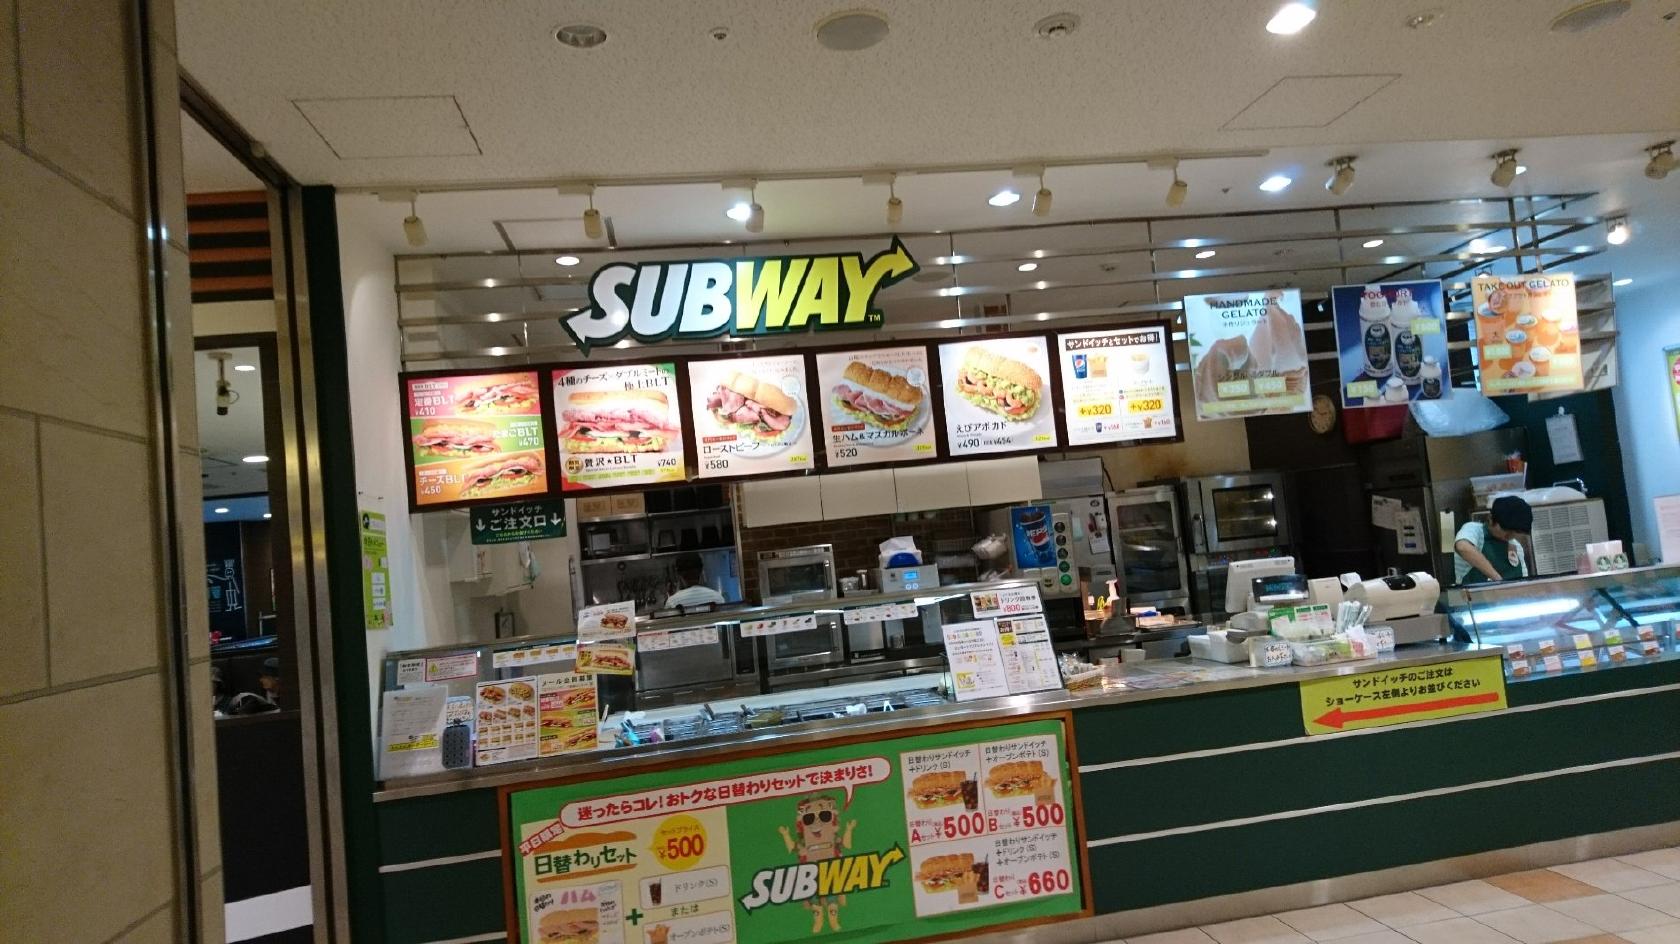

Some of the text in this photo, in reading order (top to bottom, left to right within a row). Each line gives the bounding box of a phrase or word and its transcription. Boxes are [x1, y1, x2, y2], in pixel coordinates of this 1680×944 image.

[1506, 280, 1526, 290] OUT
[1528, 278, 1570, 289] GELATO
[566, 240, 916, 348] SUBWAY
[1210, 297, 1278, 309] HANDMADE
[1221, 308, 1268, 319] GELATO
[956, 421, 1008, 434] えびアボカド
[703, 441, 760, 454] ローストビーフ
[957, 438, 980, 449] ¥490
[835, 447, 858, 459] ¥520
[657, 458, 678, 467] ¥740
[705, 459, 729, 469] ¥580
[491, 505, 543, 517] サンドイッチ
[490, 514, 546, 531] ご注文口
[1351, 667, 1453, 690] サンドイッチのご注文は
[1324, 678, 1481, 708] ショーケース左側よりお並びください
[988, 818, 998, 832] B
[1013, 803, 1064, 828] ¥500
[912, 828, 922, 843] A
[935, 812, 985, 839] ¥500
[657, 834, 704, 860] ¥500
[534, 845, 638, 876] 日替わりセット
[740, 847, 906, 912] SUBWAY
[994, 884, 1005, 899] C
[1019, 868, 1070, 896] ¥660
[671, 903, 699, 917] または
